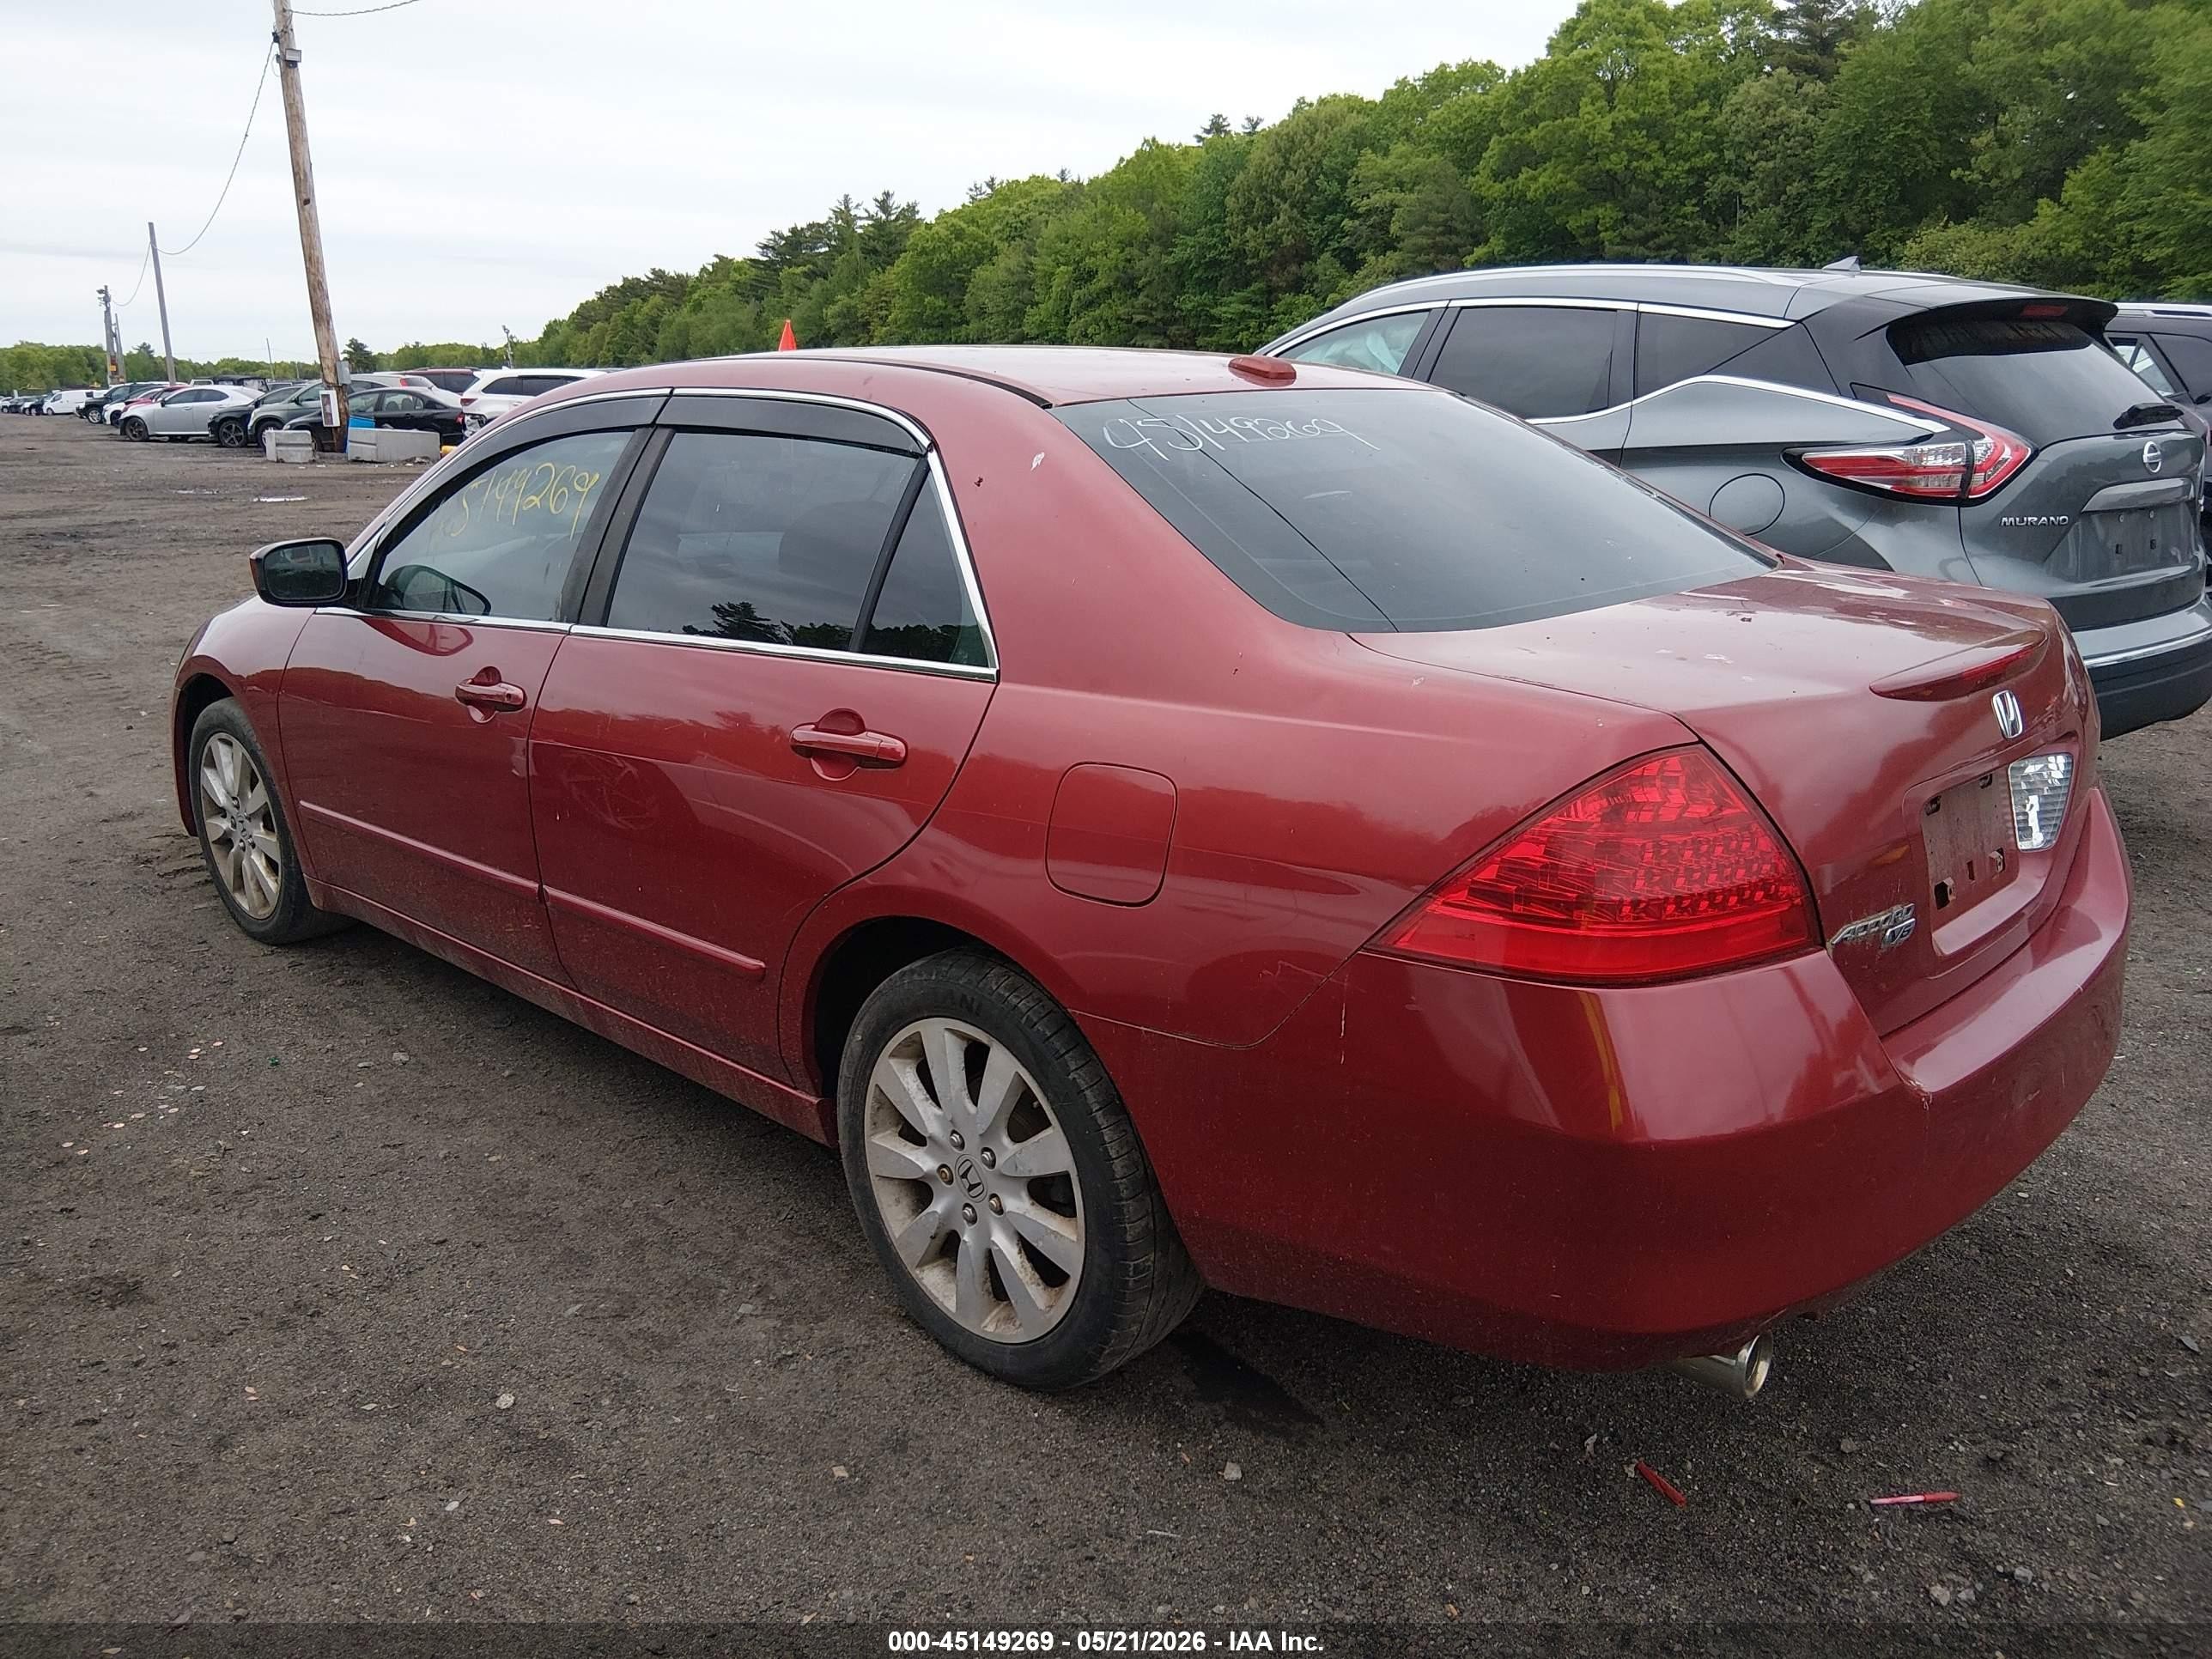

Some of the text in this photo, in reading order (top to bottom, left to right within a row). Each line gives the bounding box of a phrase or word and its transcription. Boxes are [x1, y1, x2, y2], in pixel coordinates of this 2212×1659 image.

[440, 462, 600, 541] 5149269
[2001, 515, 2069, 527] MURANO
[1885, 918, 1917, 946] V6
